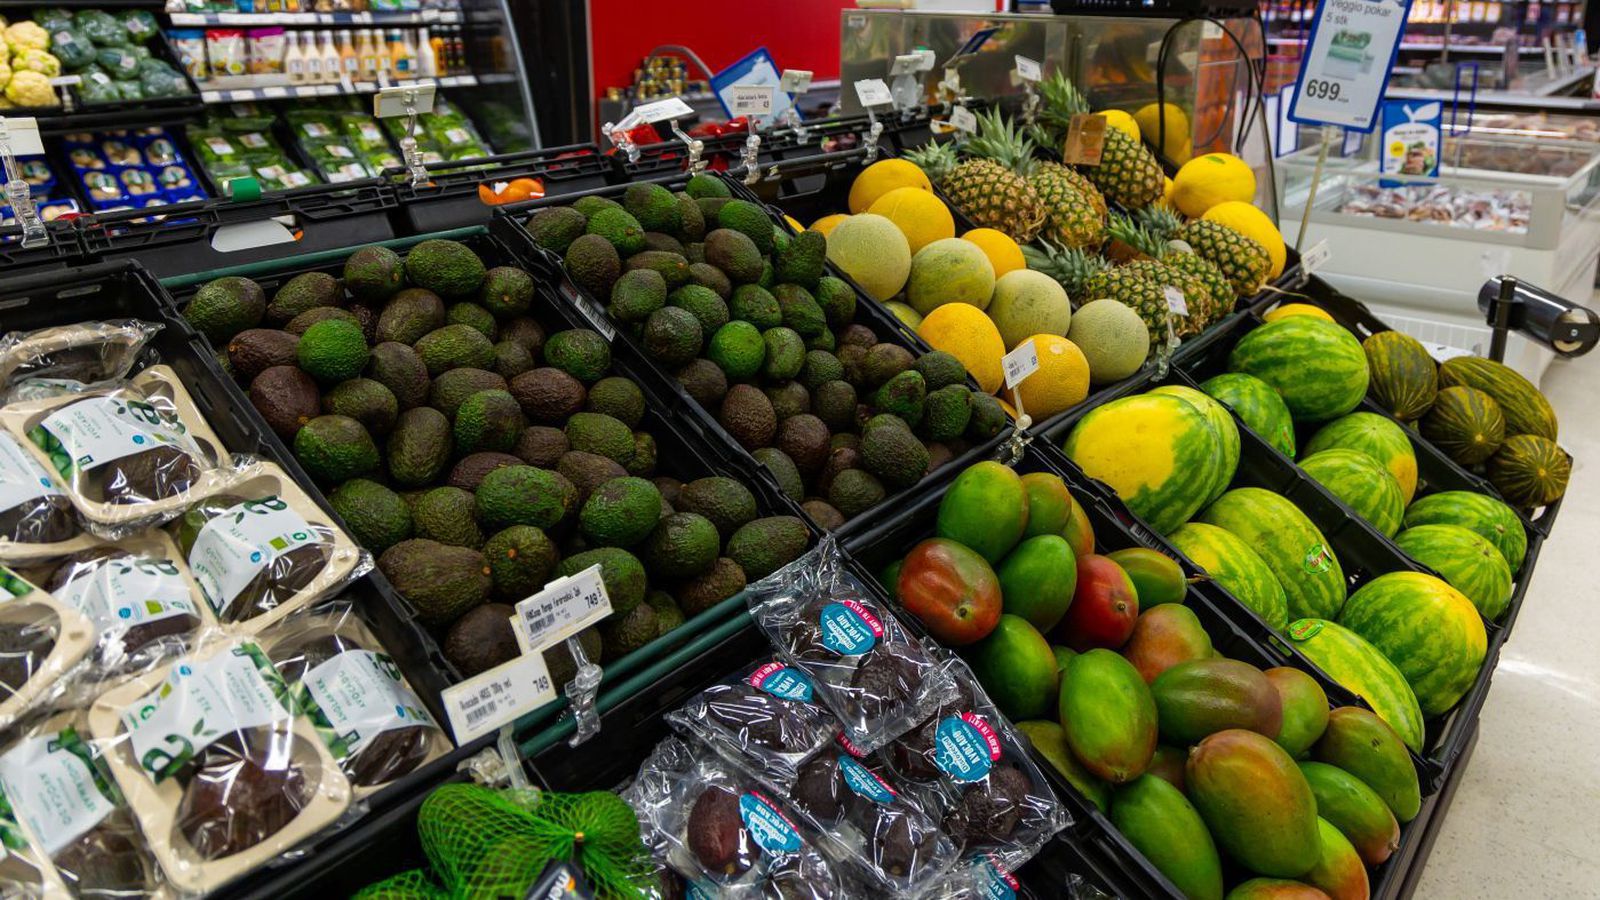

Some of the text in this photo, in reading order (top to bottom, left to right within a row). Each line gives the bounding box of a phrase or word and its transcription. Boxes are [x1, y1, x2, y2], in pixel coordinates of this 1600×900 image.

[1307, 80, 1340, 100] 699
[584, 593, 599, 608] 749
[835, 613, 865, 643] AVOCADO
[336, 669, 366, 709] AVOCADO
[533, 675, 550, 693] 749
[952, 729, 980, 764] AVOCADO
[755, 804, 789, 834] AVOCADO
